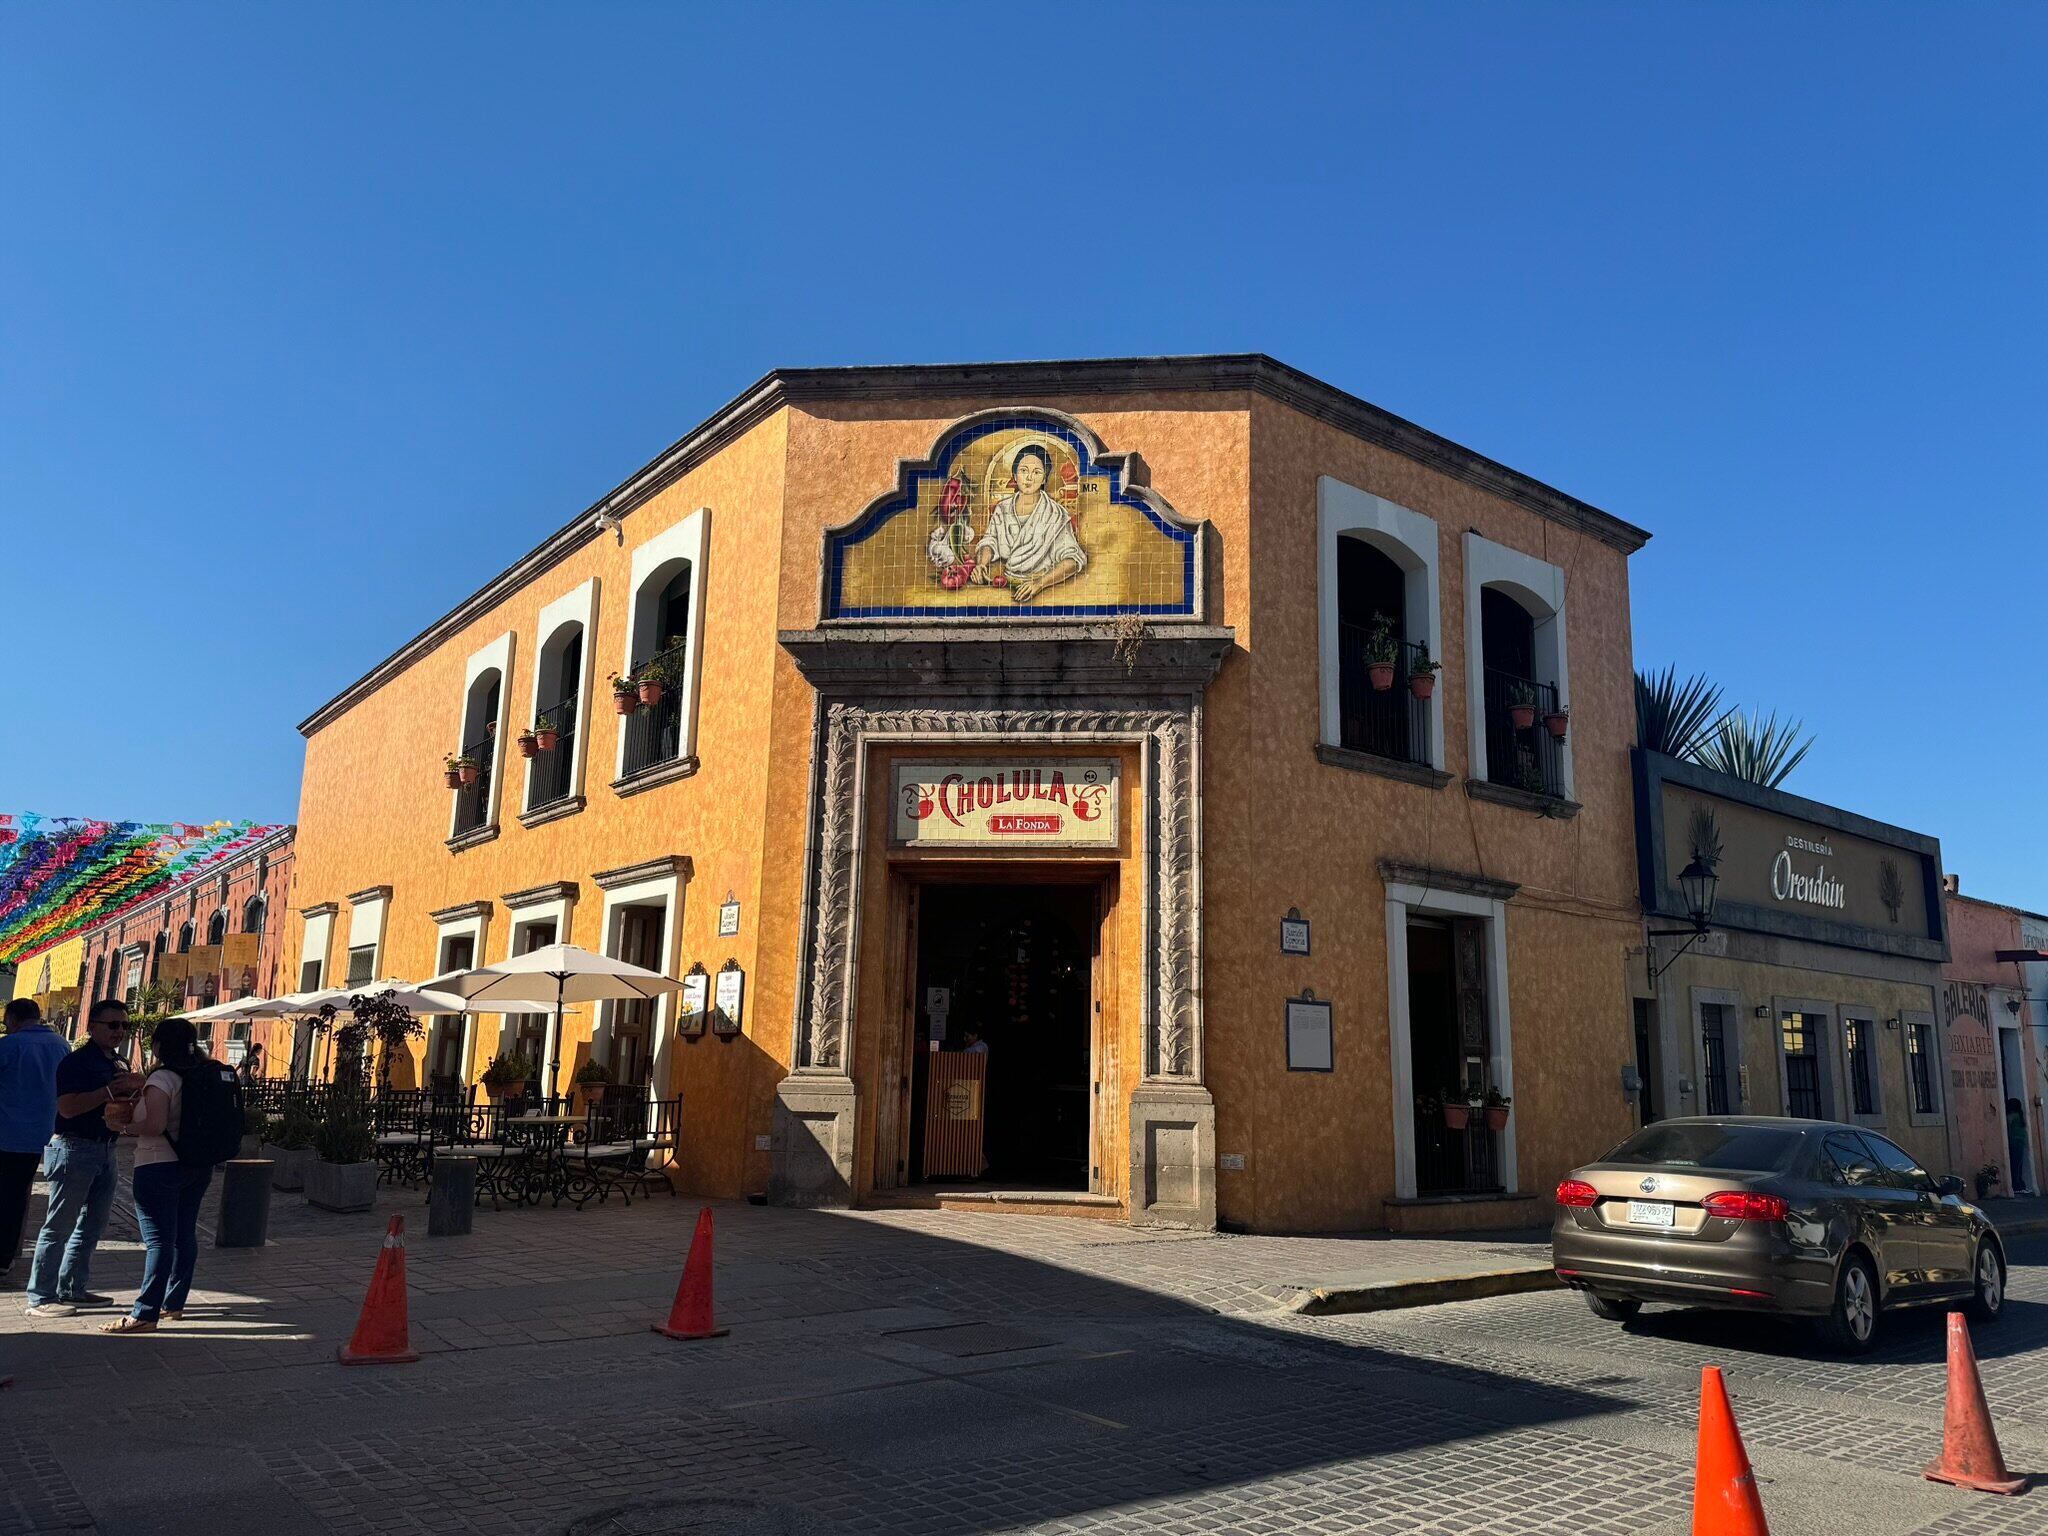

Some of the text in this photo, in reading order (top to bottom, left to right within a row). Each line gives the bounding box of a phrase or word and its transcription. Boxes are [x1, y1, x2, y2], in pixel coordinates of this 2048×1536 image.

[938, 769, 1069, 827] CHOLULA
[999, 818, 1050, 829] LA FONDA
[1773, 850, 1845, 909] Orendain
